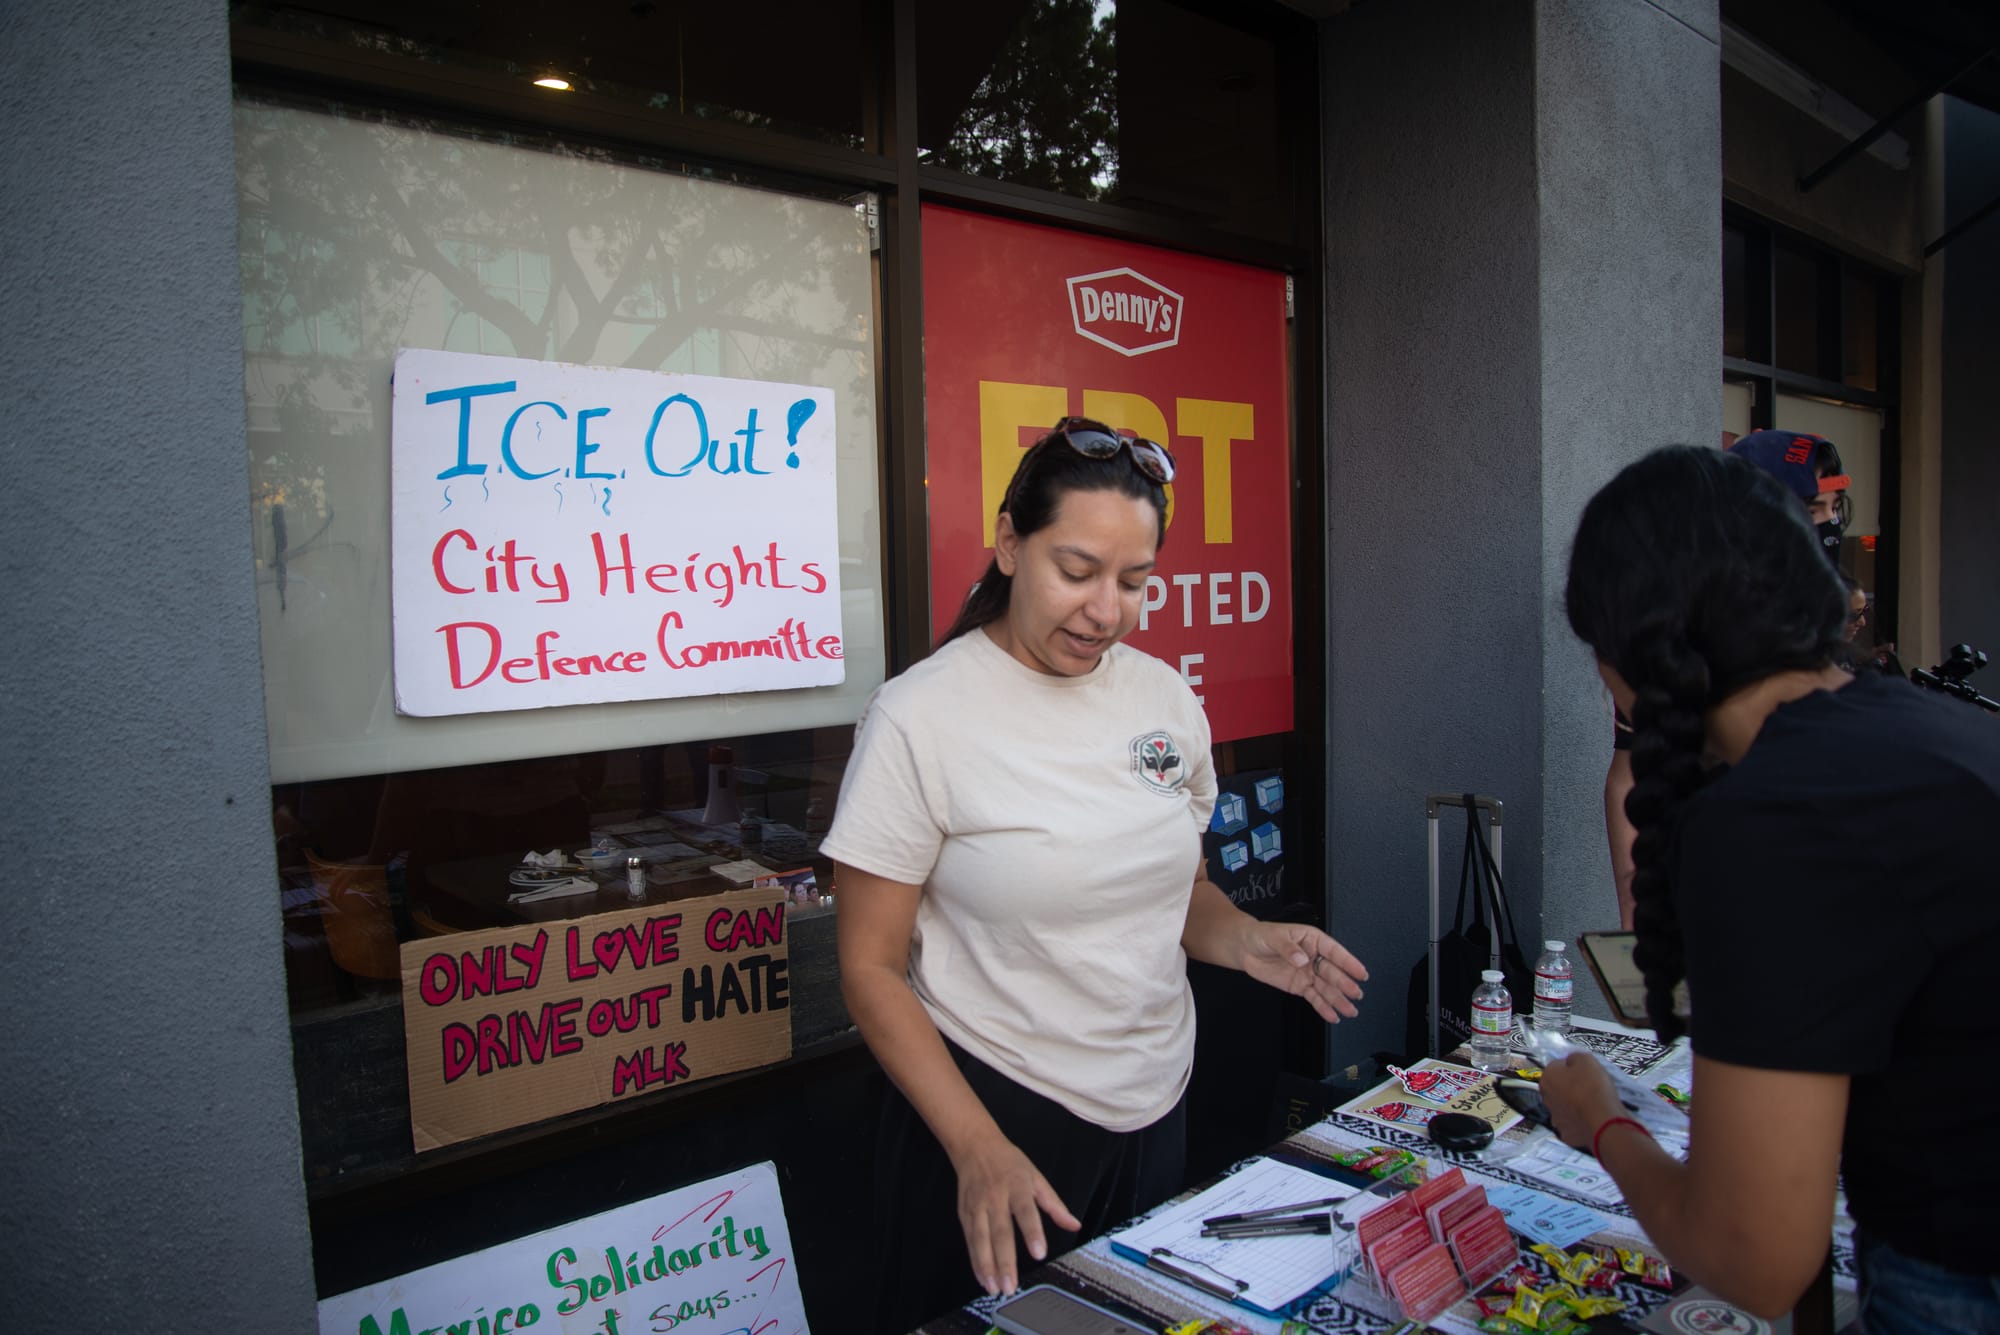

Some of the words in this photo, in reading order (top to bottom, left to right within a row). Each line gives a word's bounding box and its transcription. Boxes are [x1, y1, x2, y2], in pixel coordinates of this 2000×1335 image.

[1080, 287, 1172, 333] Denny's
[432, 529, 570, 603] City
[591, 532, 827, 608] Heights
[1139, 571, 1271, 631] PTED
[436, 621, 647, 689] Defence
[419, 928, 549, 1006] ONLY
[705, 902, 785, 952] CAN
[442, 998, 584, 1084] DRIVE
[587, 984, 672, 1037] OUT
[682, 954, 790, 1024] HATE
[612, 1040, 691, 1097] MLK
[547, 1216, 771, 1316] Solidarity
[360, 1303, 541, 1335] Mxico
